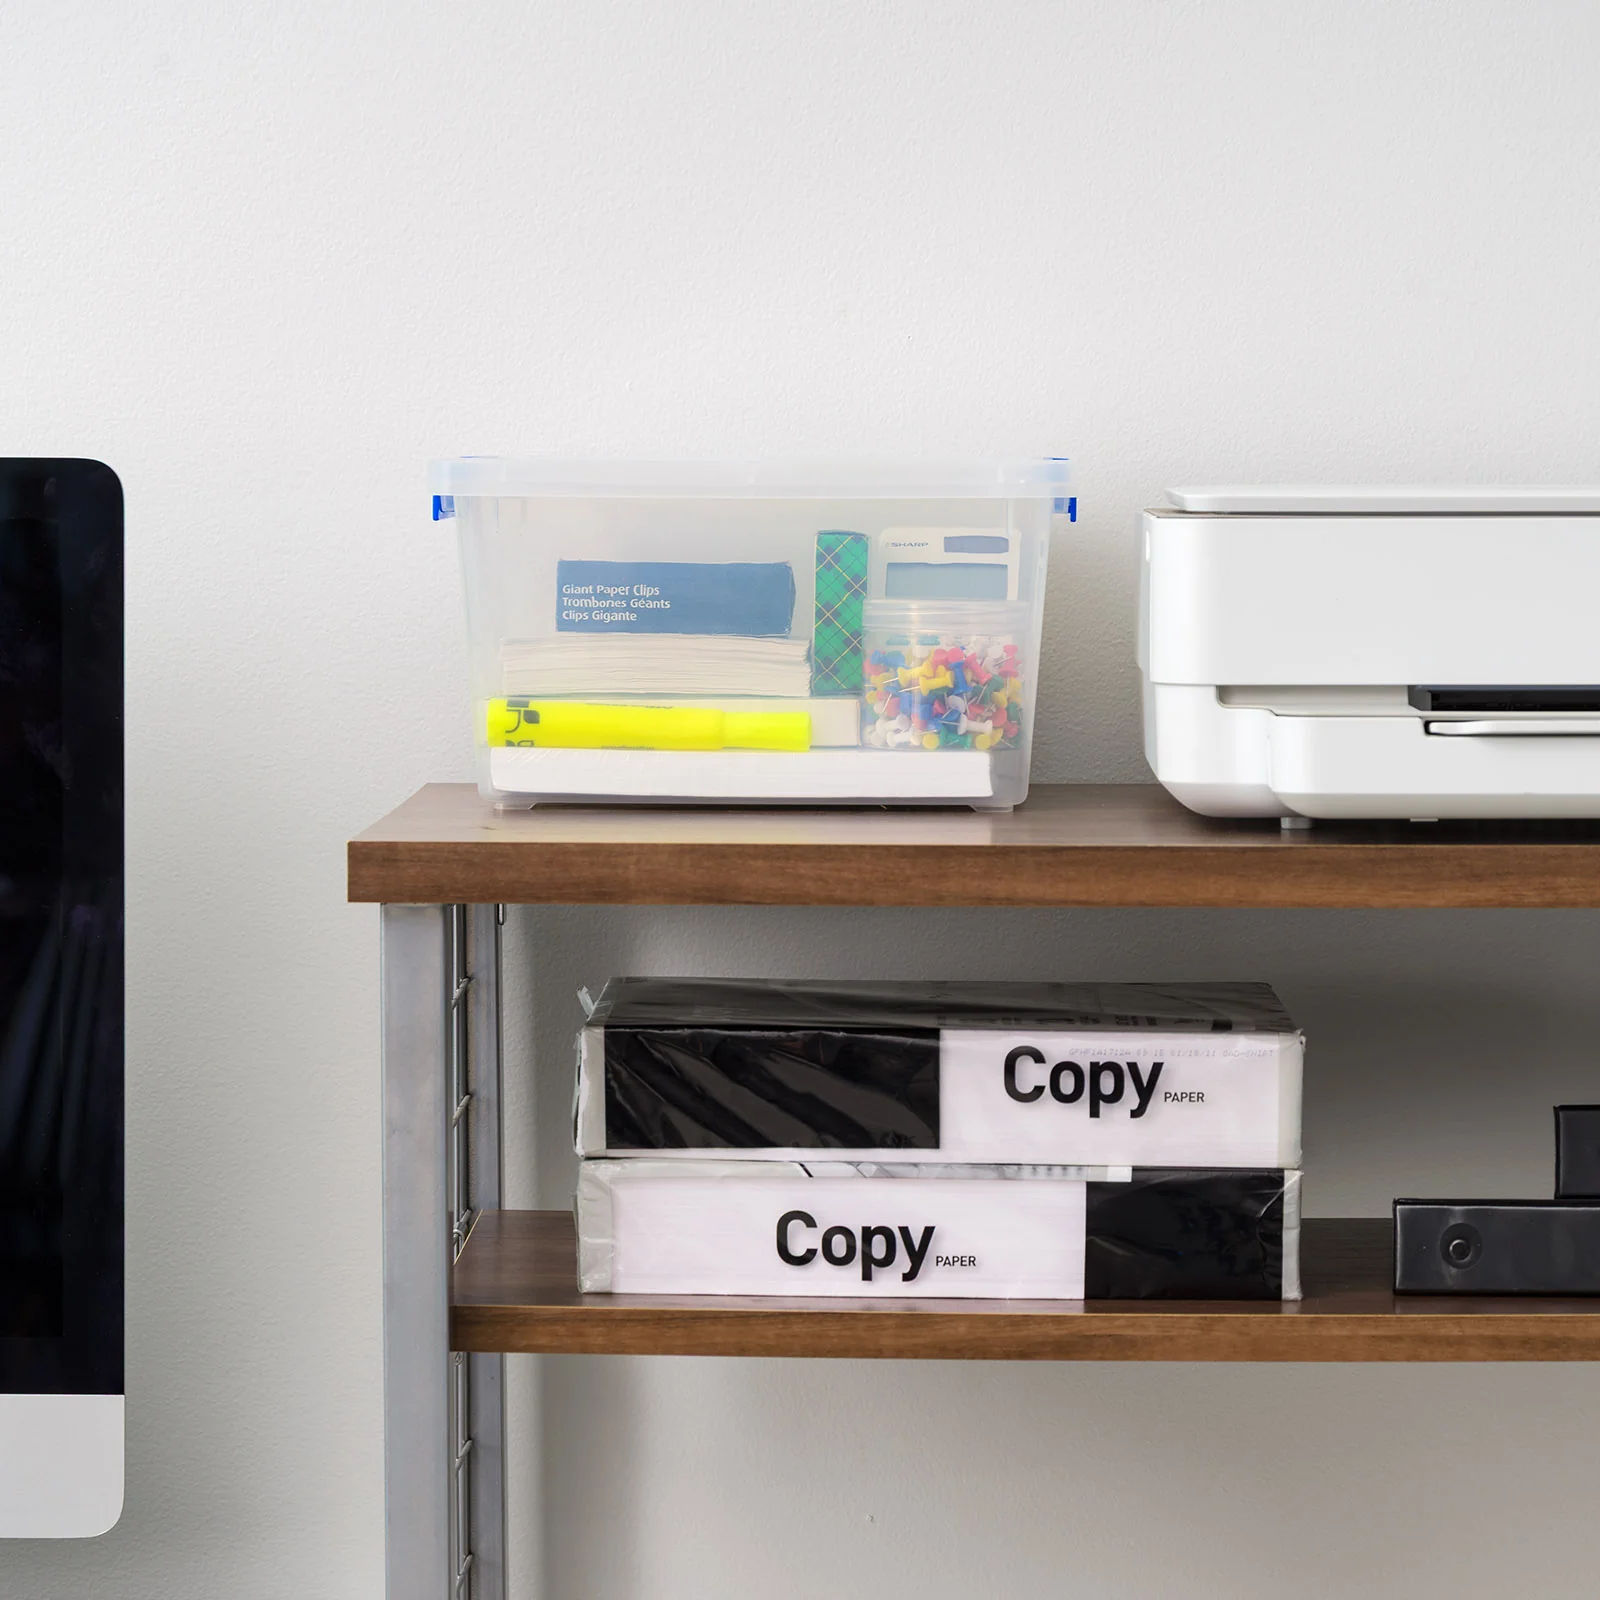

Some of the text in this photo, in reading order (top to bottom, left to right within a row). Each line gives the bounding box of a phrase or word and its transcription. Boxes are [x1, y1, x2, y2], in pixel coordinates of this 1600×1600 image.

[562, 584, 660, 598] Giant Paper Clips
[562, 596, 671, 609] Trombones Géants
[562, 610, 638, 624] Clips Gigante
[1003, 1045, 1205, 1119] Copy PAPER
[776, 1210, 977, 1283] Copy PAPER
